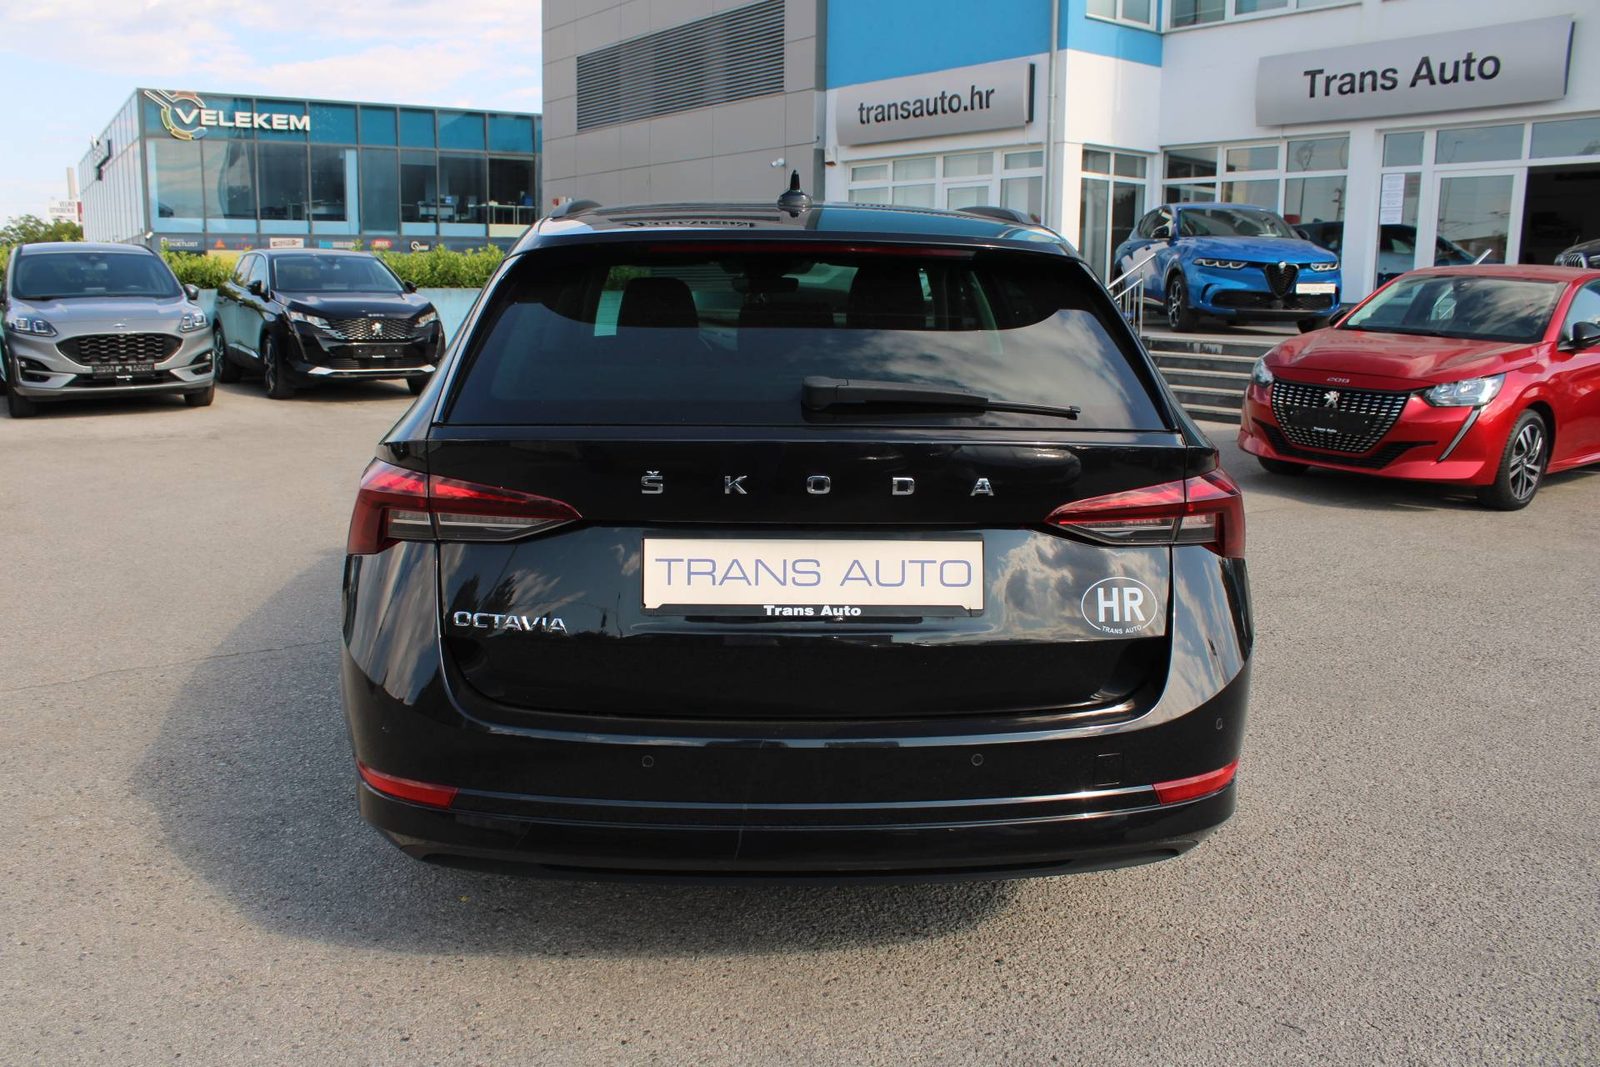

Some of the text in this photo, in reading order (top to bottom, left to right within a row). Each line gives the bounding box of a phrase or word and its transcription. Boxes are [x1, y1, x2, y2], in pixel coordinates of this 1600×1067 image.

[1303, 51, 1501, 99] Trans Auto
[858, 84, 995, 125] transauto.hr
[175, 107, 310, 132] VELEKEM
[641, 470, 995, 497] ŠKODA
[655, 558, 972, 588] TRANS AUTO
[763, 604, 862, 617] Trans Auto
[1097, 587, 1146, 623] HR
[453, 610, 568, 634] OCTAVIA
[1102, 624, 1142, 635] TRANS AUTO
